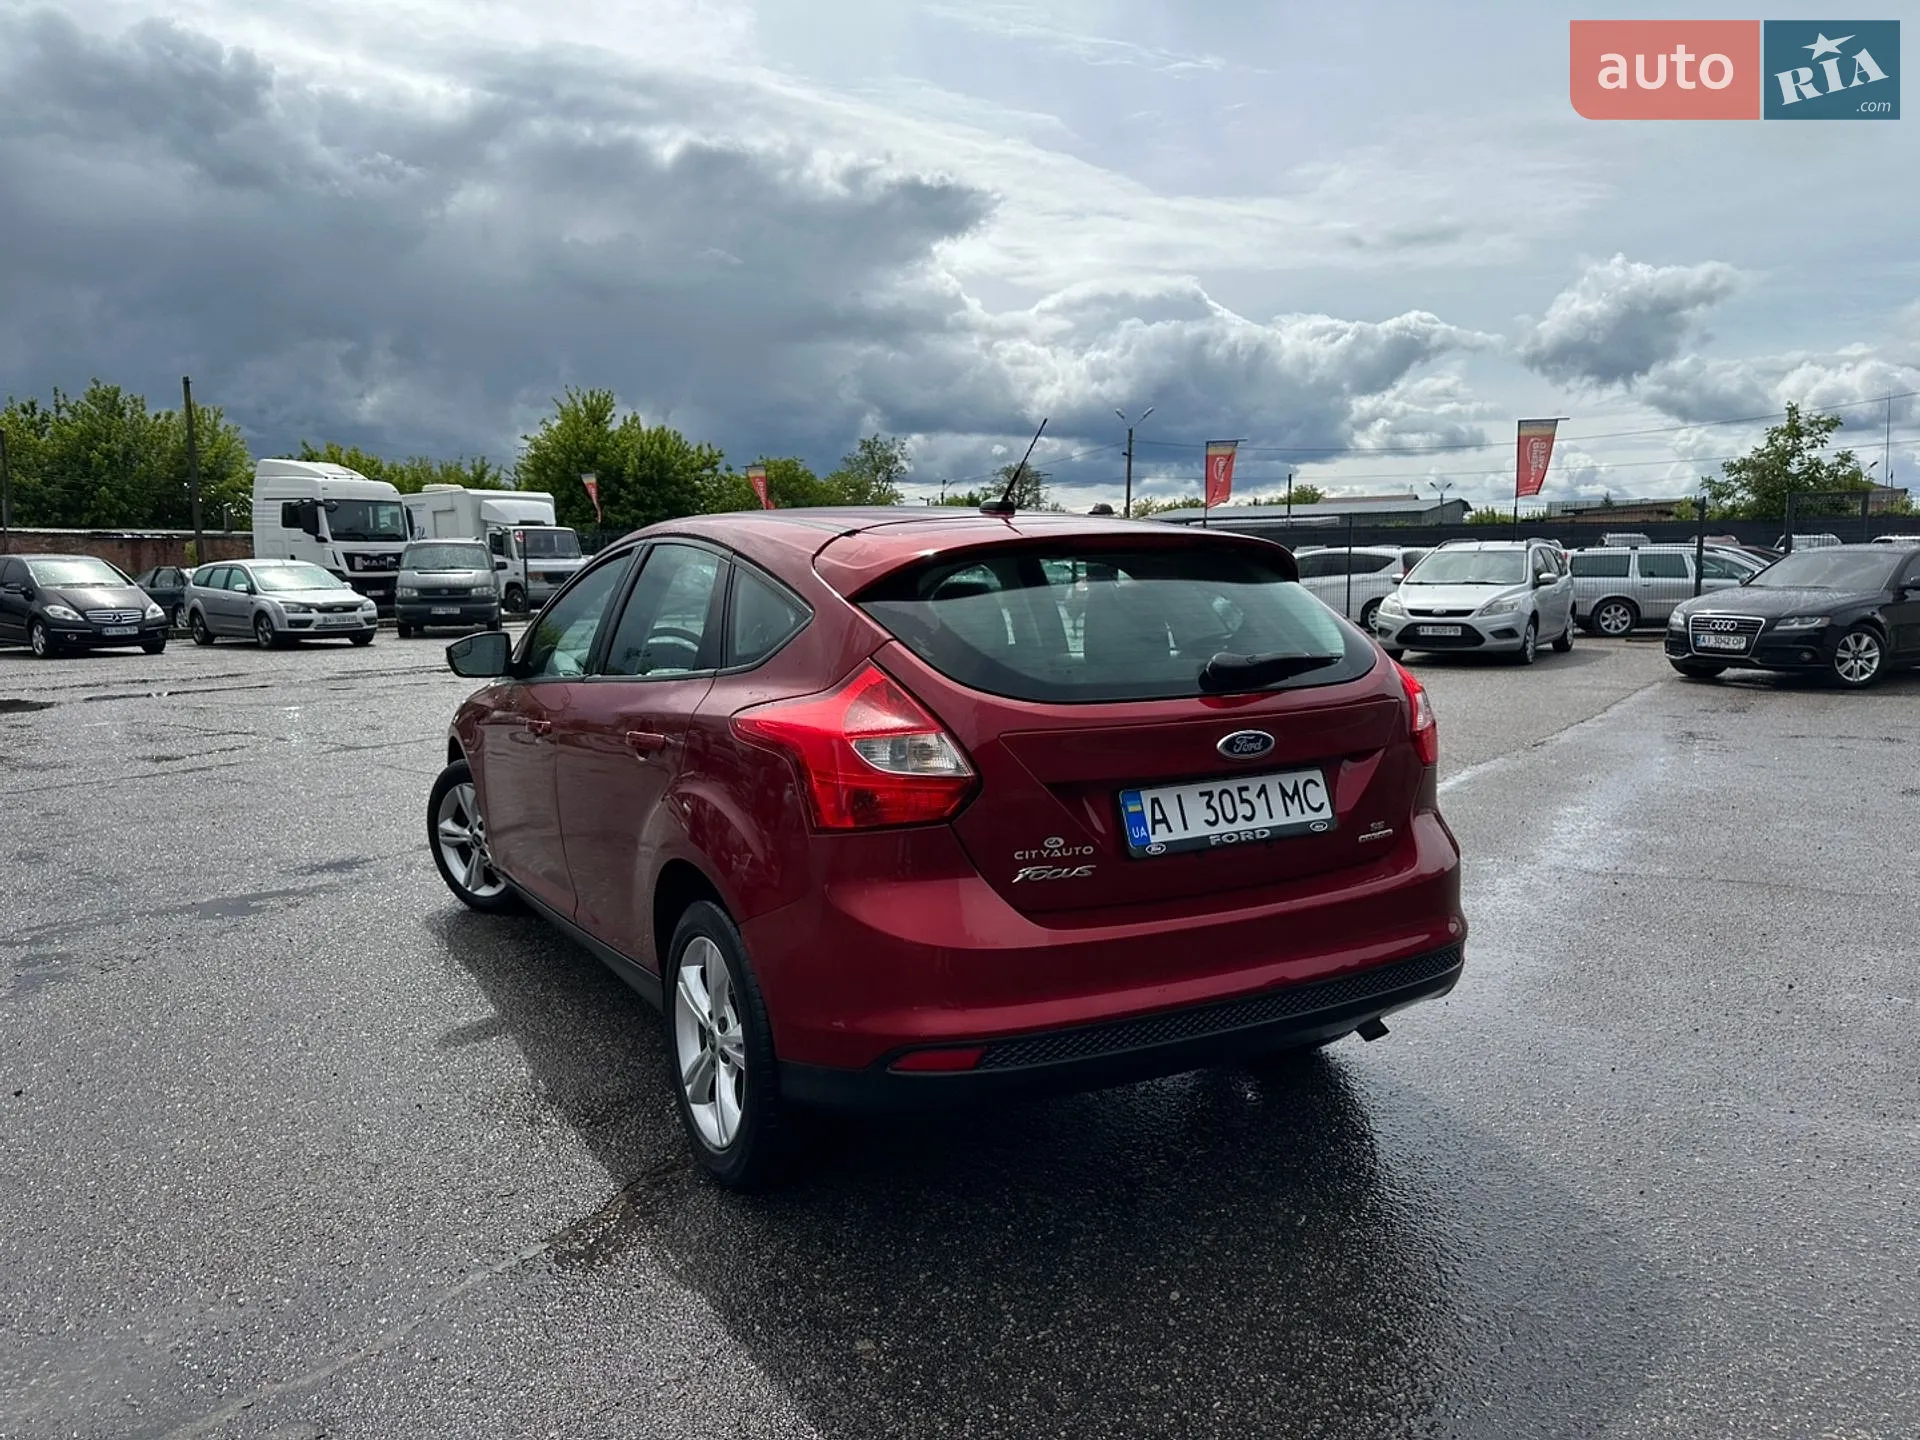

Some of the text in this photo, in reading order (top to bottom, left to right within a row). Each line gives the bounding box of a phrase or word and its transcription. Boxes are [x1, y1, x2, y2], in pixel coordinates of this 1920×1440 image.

[1233, 736, 1263, 753] Ford
[1150, 778, 1325, 835] AI 3051 MC
[1131, 825, 1147, 838] UA
[1209, 828, 1271, 846] FORD
